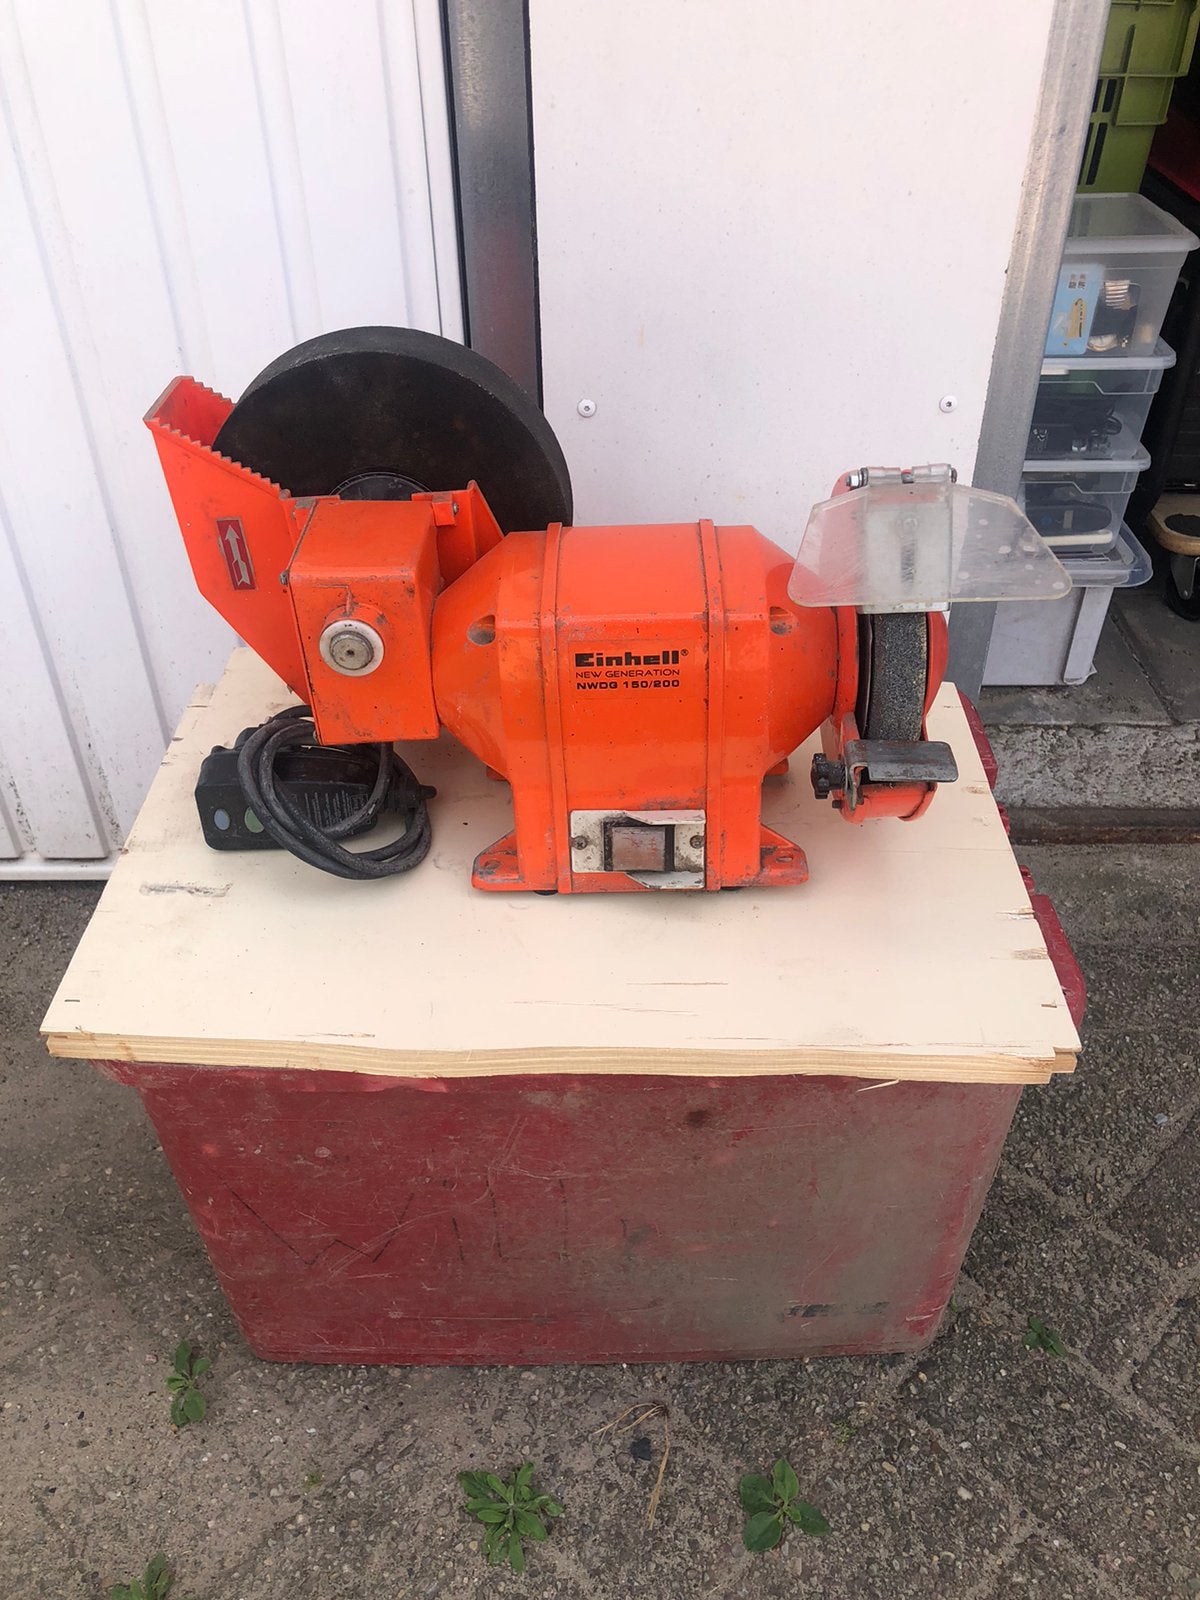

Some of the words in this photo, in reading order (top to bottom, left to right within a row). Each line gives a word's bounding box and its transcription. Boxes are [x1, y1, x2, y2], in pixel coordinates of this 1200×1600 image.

[575, 671, 602, 679] NEW
[605, 669, 680, 678] GENERATION
[576, 681, 618, 690] NWDG
[623, 679, 680, 689] 150/200
